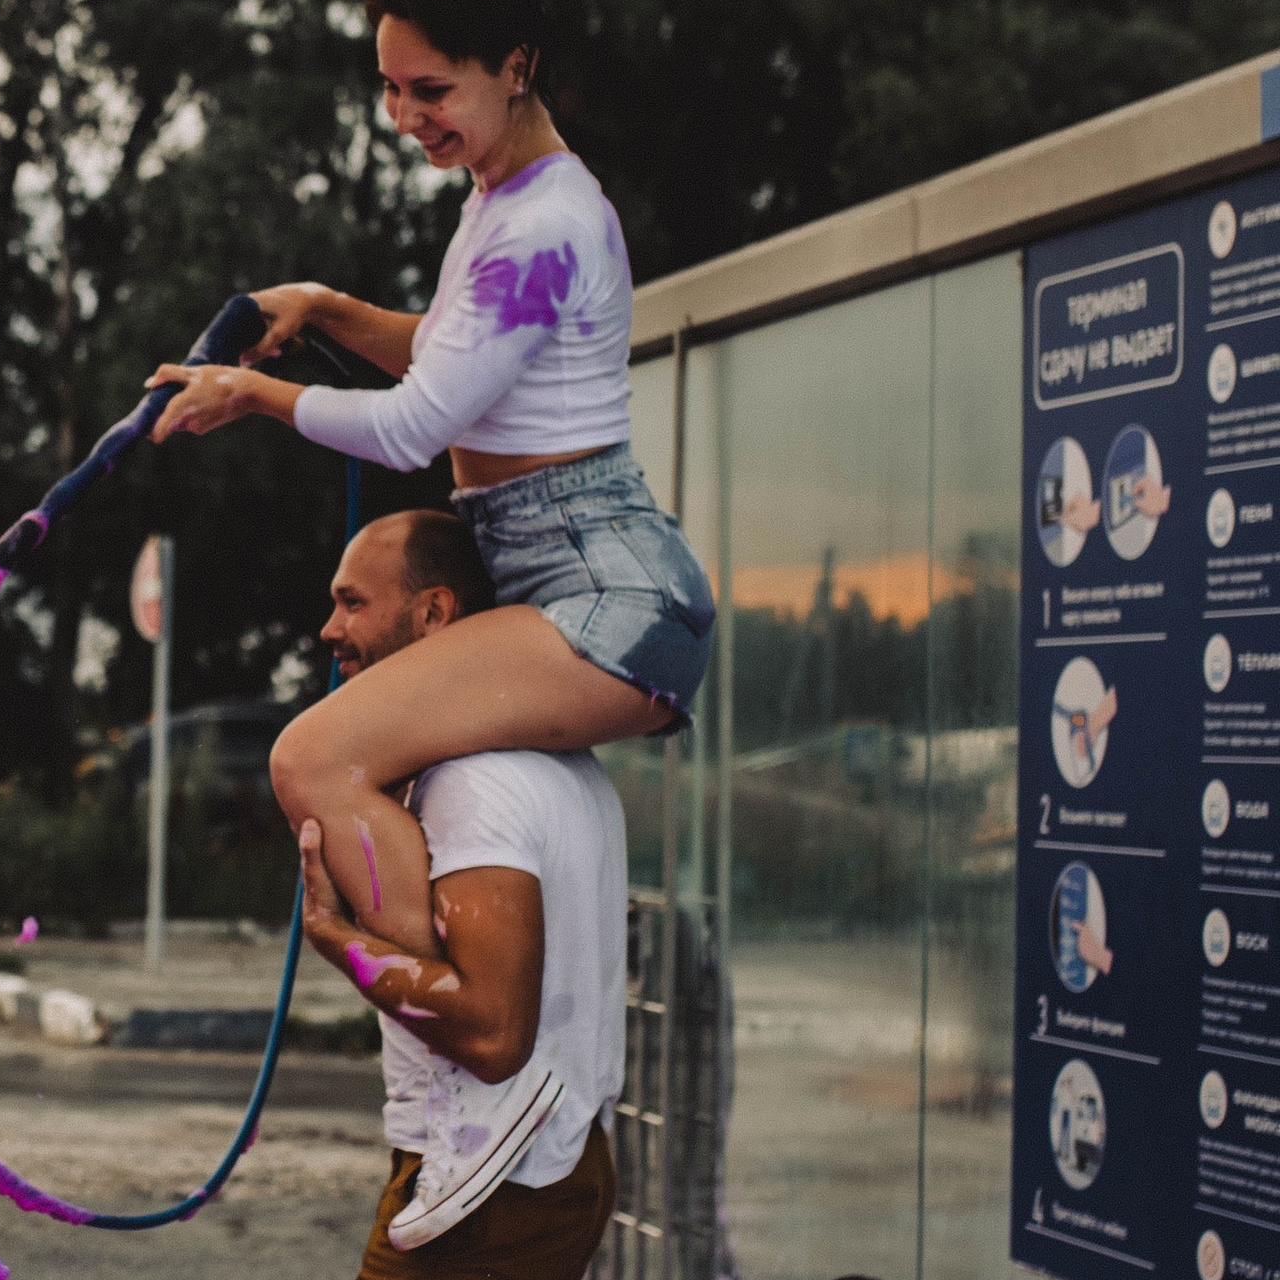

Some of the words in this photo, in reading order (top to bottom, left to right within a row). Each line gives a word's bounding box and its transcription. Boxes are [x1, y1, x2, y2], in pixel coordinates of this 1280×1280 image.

[1067, 278, 1148, 332] терминал
[1040, 344, 1087, 386] сдачу
[1088, 339, 1110, 371] не
[1111, 322, 1176, 368] выдает
[1039, 793, 1051, 835] 2
[1037, 994, 1048, 1036] 3
[1031, 1188, 1044, 1224] 4
